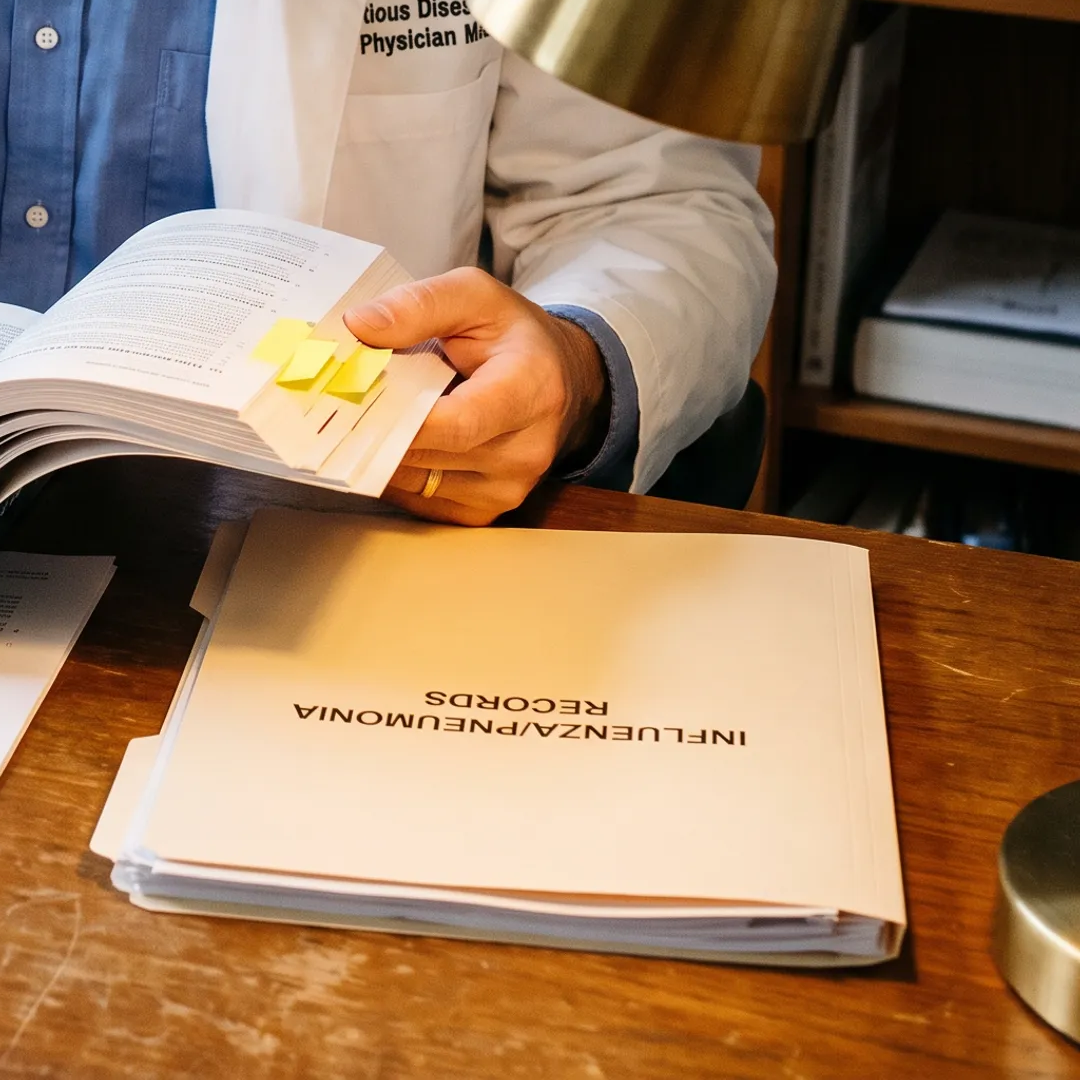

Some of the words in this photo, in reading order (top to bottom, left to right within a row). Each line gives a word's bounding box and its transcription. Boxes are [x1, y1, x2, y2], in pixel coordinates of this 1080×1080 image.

[360, 27, 457, 57] Physician
[424, 690, 609, 717] RECORDS
[293, 703, 747, 746] INFLUENZA/PNEUMONIA
